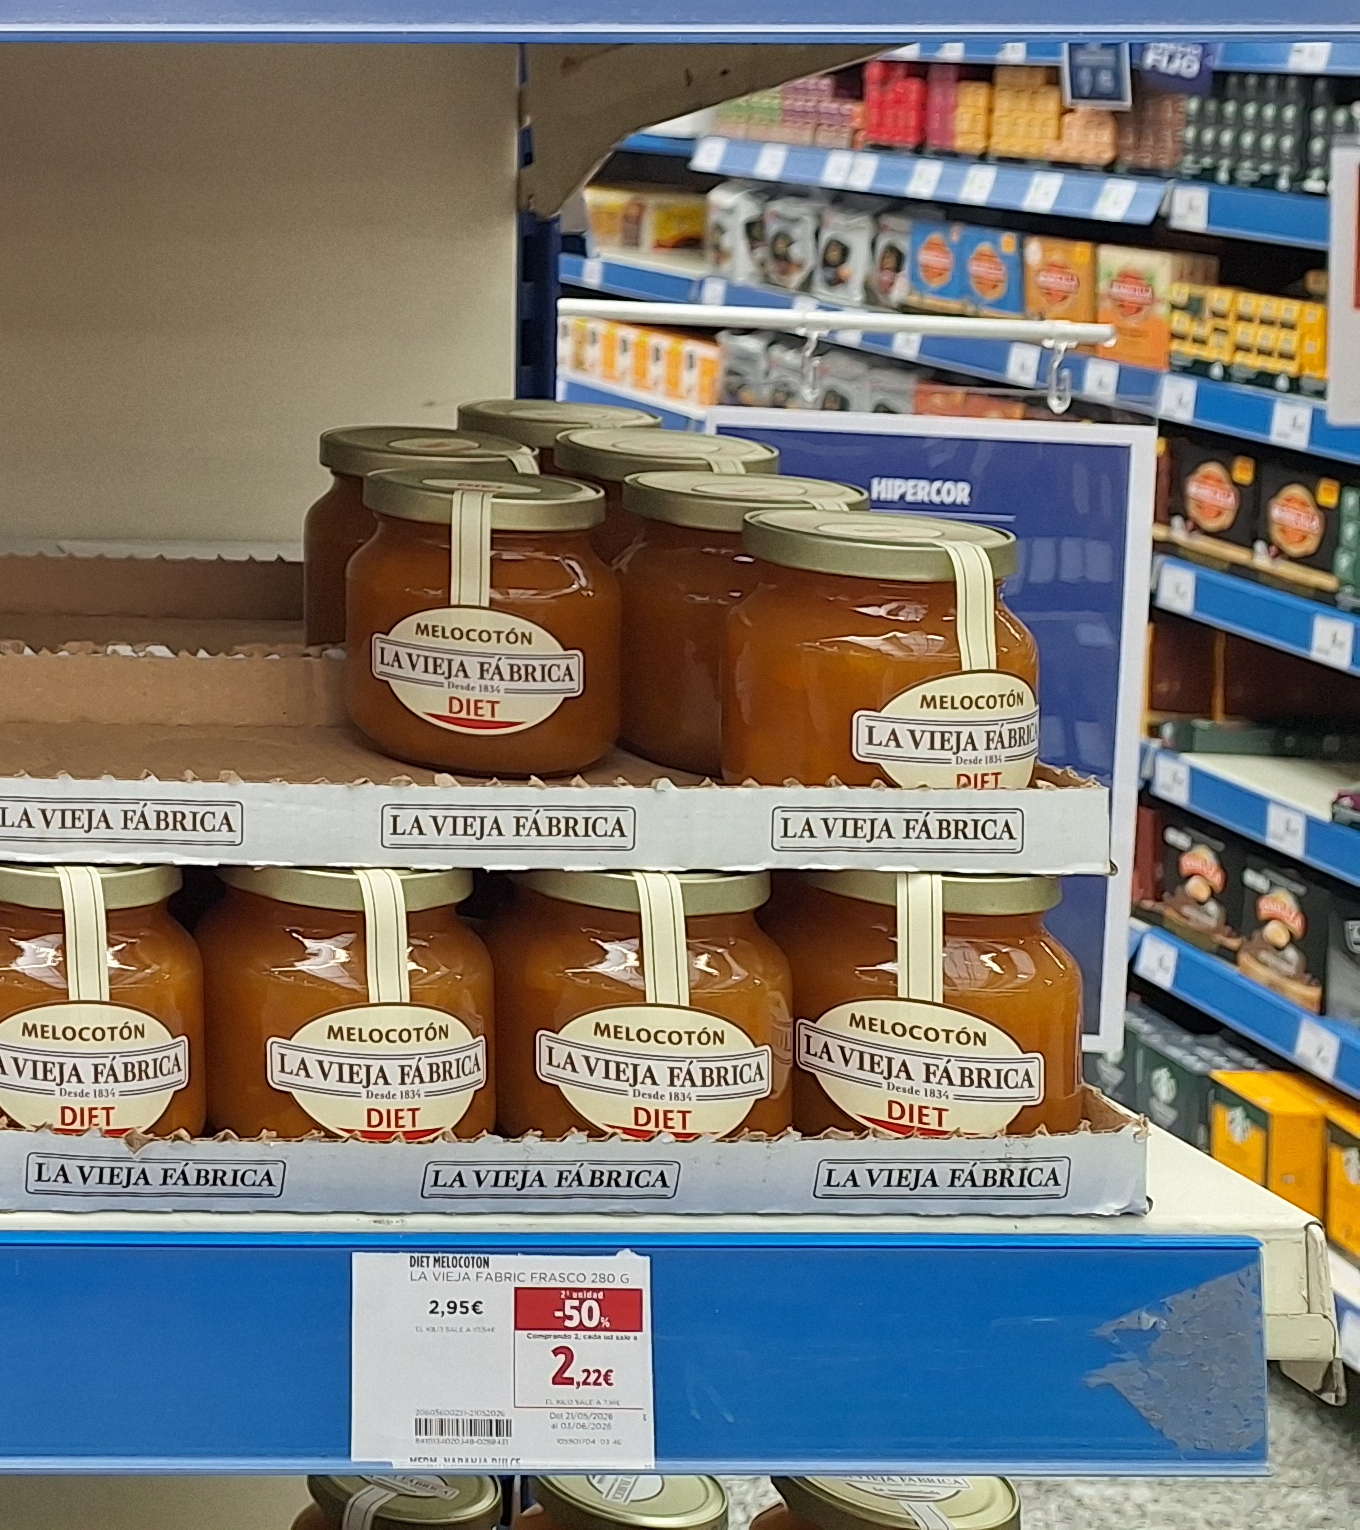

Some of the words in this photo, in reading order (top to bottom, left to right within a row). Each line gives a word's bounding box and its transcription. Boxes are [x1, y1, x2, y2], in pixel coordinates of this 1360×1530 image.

[871, 477, 971, 505] HIPERCOR
[415, 622, 532, 645] MELOCOTÓN
[379, 647, 403, 670] LA
[406, 651, 469, 680] VIEJA
[477, 656, 575, 683] FÁBRICA
[449, 696, 500, 718] DIET
[22, 1022, 144, 1041] MELOCOTÓN
[13, 1057, 84, 1086] VIEJA
[91, 1049, 183, 1086] FÁBRICA
[60, 1088, 88, 1099] Desde
[92, 1088, 116, 1098] 1834
[60, 1106, 114, 1128] DIET
[36, 1162, 72, 1184] LA
[78, 1164, 152, 1187] VIEJA
[158, 1160, 276, 1188] FÁBRICA
[409, 1256, 429, 1267] DIET
[432, 1255, 488, 1268] MELOCOTON
[409, 1270, 426, 1280] LA
[431, 1270, 470, 1281] VIEJA
[475, 1271, 525, 1282] FABRIC
[530, 1272, 585, 1282] FRASCO
[590, 1272, 614, 1282] 280
[619, 1272, 629, 1282] G
[428, 1299, 483, 1316] 2,95€
[550, 1345, 613, 1388] 2,22€
